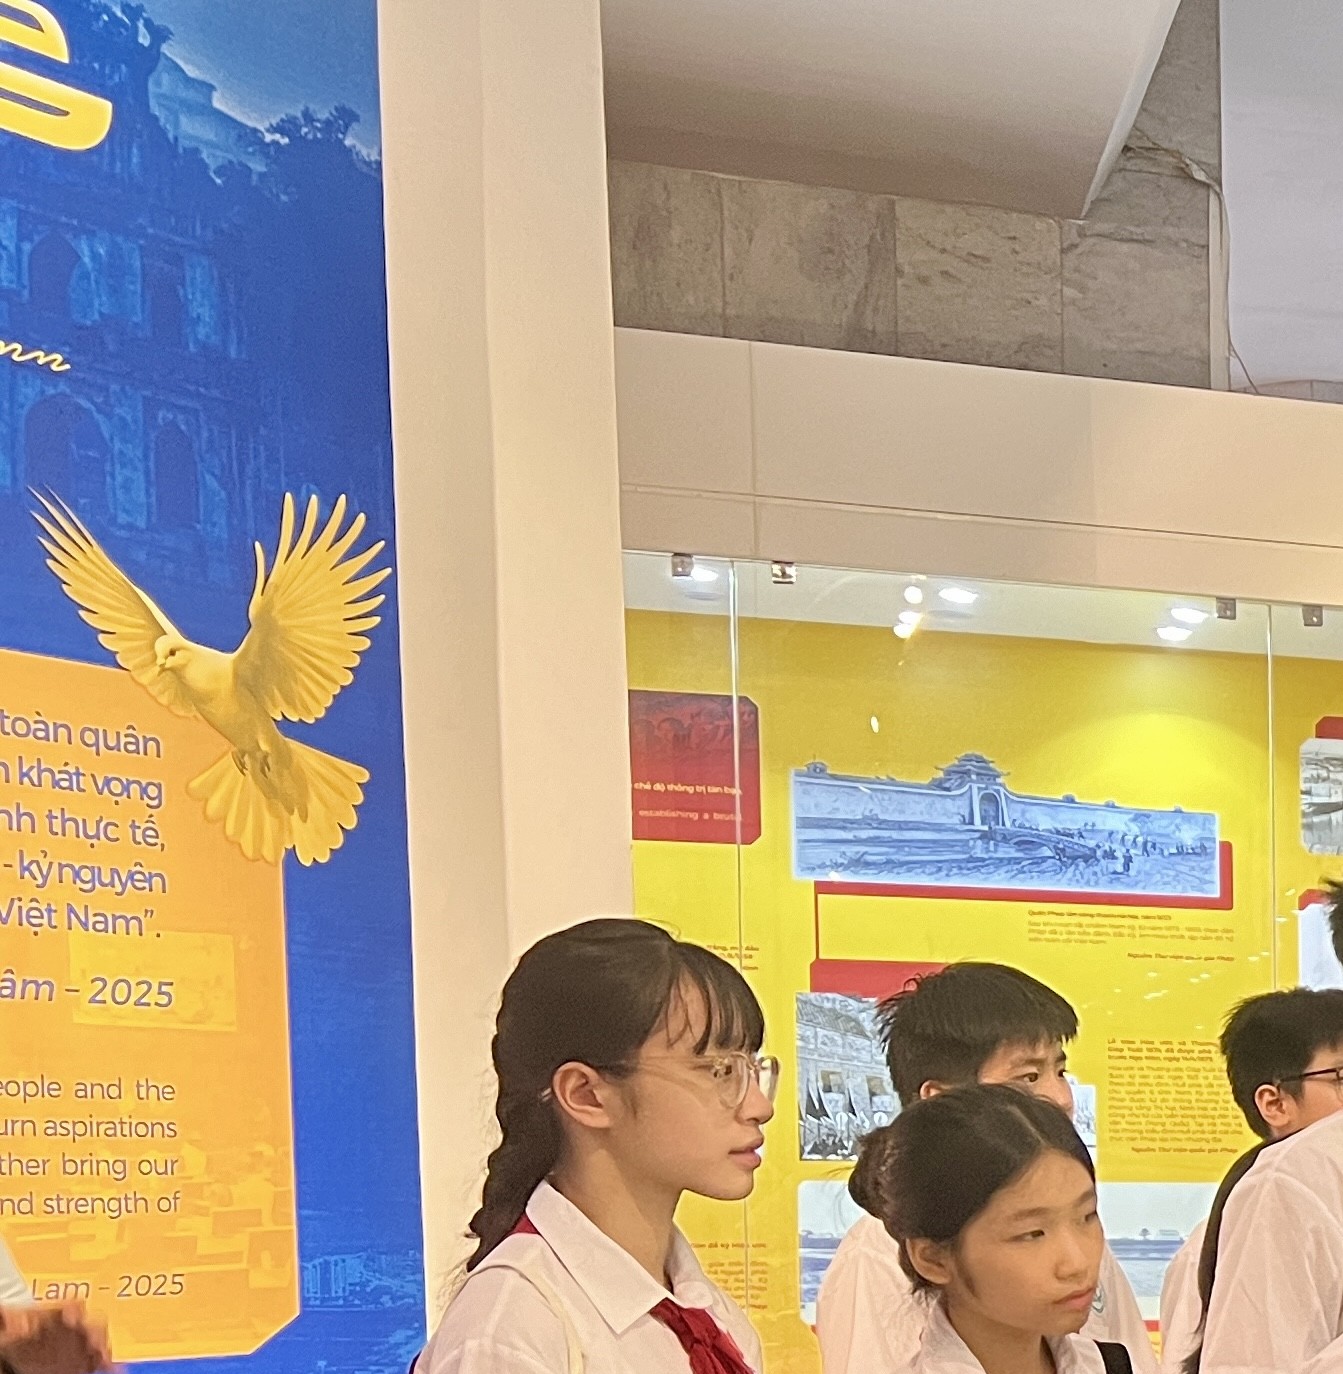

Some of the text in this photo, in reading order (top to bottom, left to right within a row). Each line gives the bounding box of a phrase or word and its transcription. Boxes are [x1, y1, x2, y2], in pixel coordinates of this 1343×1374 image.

[78, 724, 161, 758] quân
[16, 755, 86, 793] khát
[88, 772, 162, 810] vọng
[44, 807, 120, 849] thực
[127, 813, 165, 852] tế,
[17, 849, 54, 889] kỷ
[56, 861, 166, 896] nguyên
[0, 968, 55, 1002] âm
[86, 976, 175, 1008] 2025
[0, 1073, 176, 1104] eople and the
[42, 1113, 178, 1144] aspirations
[0, 1151, 179, 1182] ther bring our
[0, 1190, 180, 1220] nd strength of
[31, 1278, 90, 1301] Lam
[115, 1273, 185, 1297] 2025
